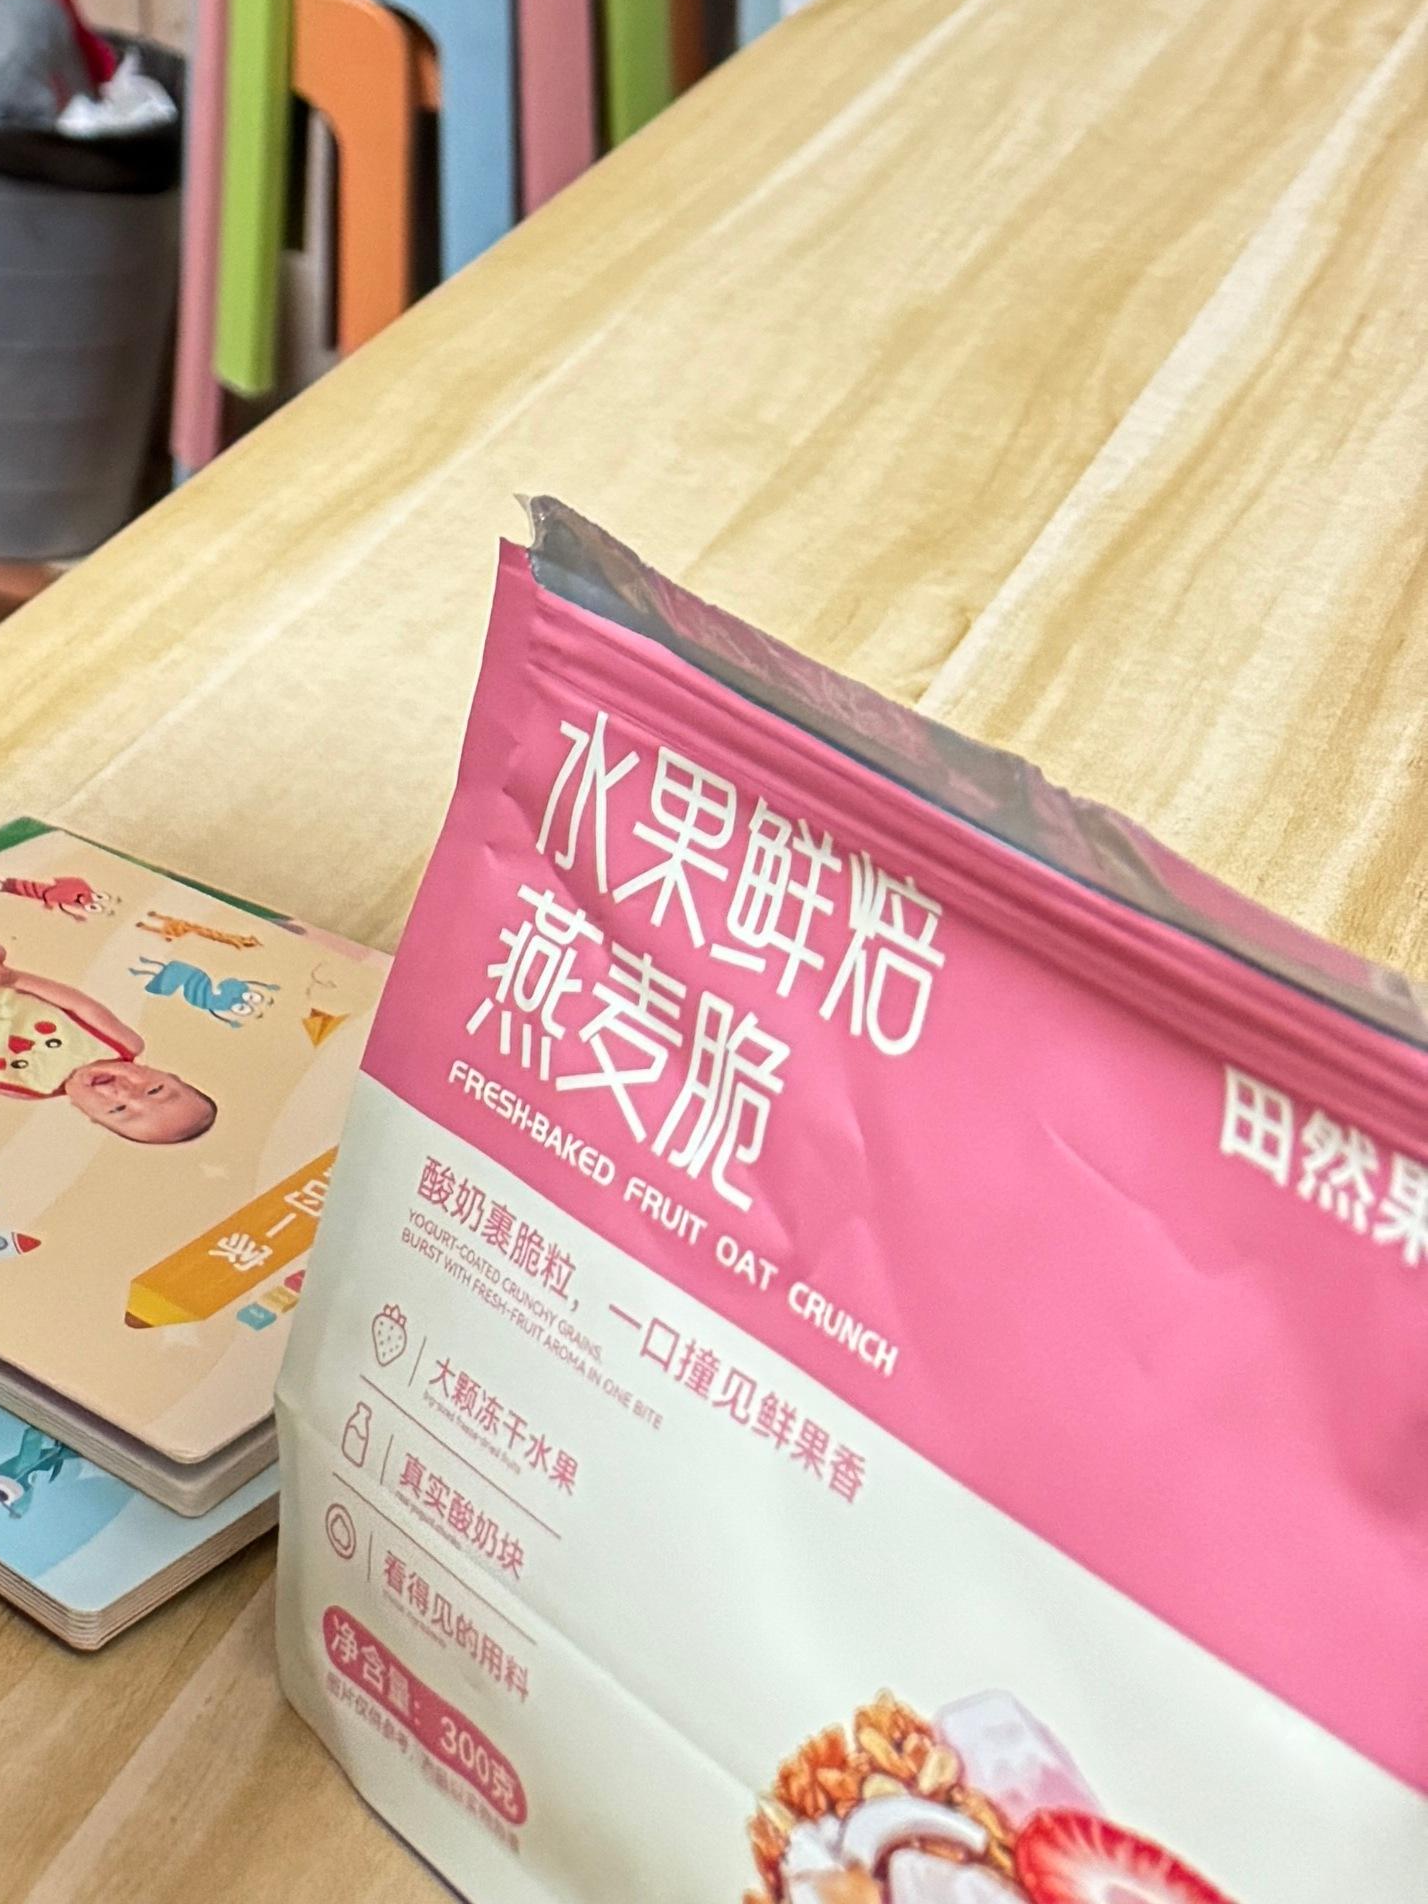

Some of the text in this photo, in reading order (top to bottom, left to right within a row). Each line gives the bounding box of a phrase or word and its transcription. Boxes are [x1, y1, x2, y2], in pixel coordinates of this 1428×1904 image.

[535, 710, 946, 1056] 水果鲜焙
[465, 883, 791, 1212] 燕麦脆
[407, 1208, 502, 1285] YOGURT-COATED
[501, 1276, 559, 1328] CRUNCHY
[447, 1059, 900, 1377] FRESH-BAKED FRUIT OAT CRUNCH
[401, 1226, 665, 1430] BURST WITH FRESH-FRUIT AROMA IN ONE BITE
[399, 1452, 526, 1580] 真实酸奶块
[428, 1357, 580, 1497] 大颗冻干水果
[383, 1549, 529, 1704] 看得见的用料
